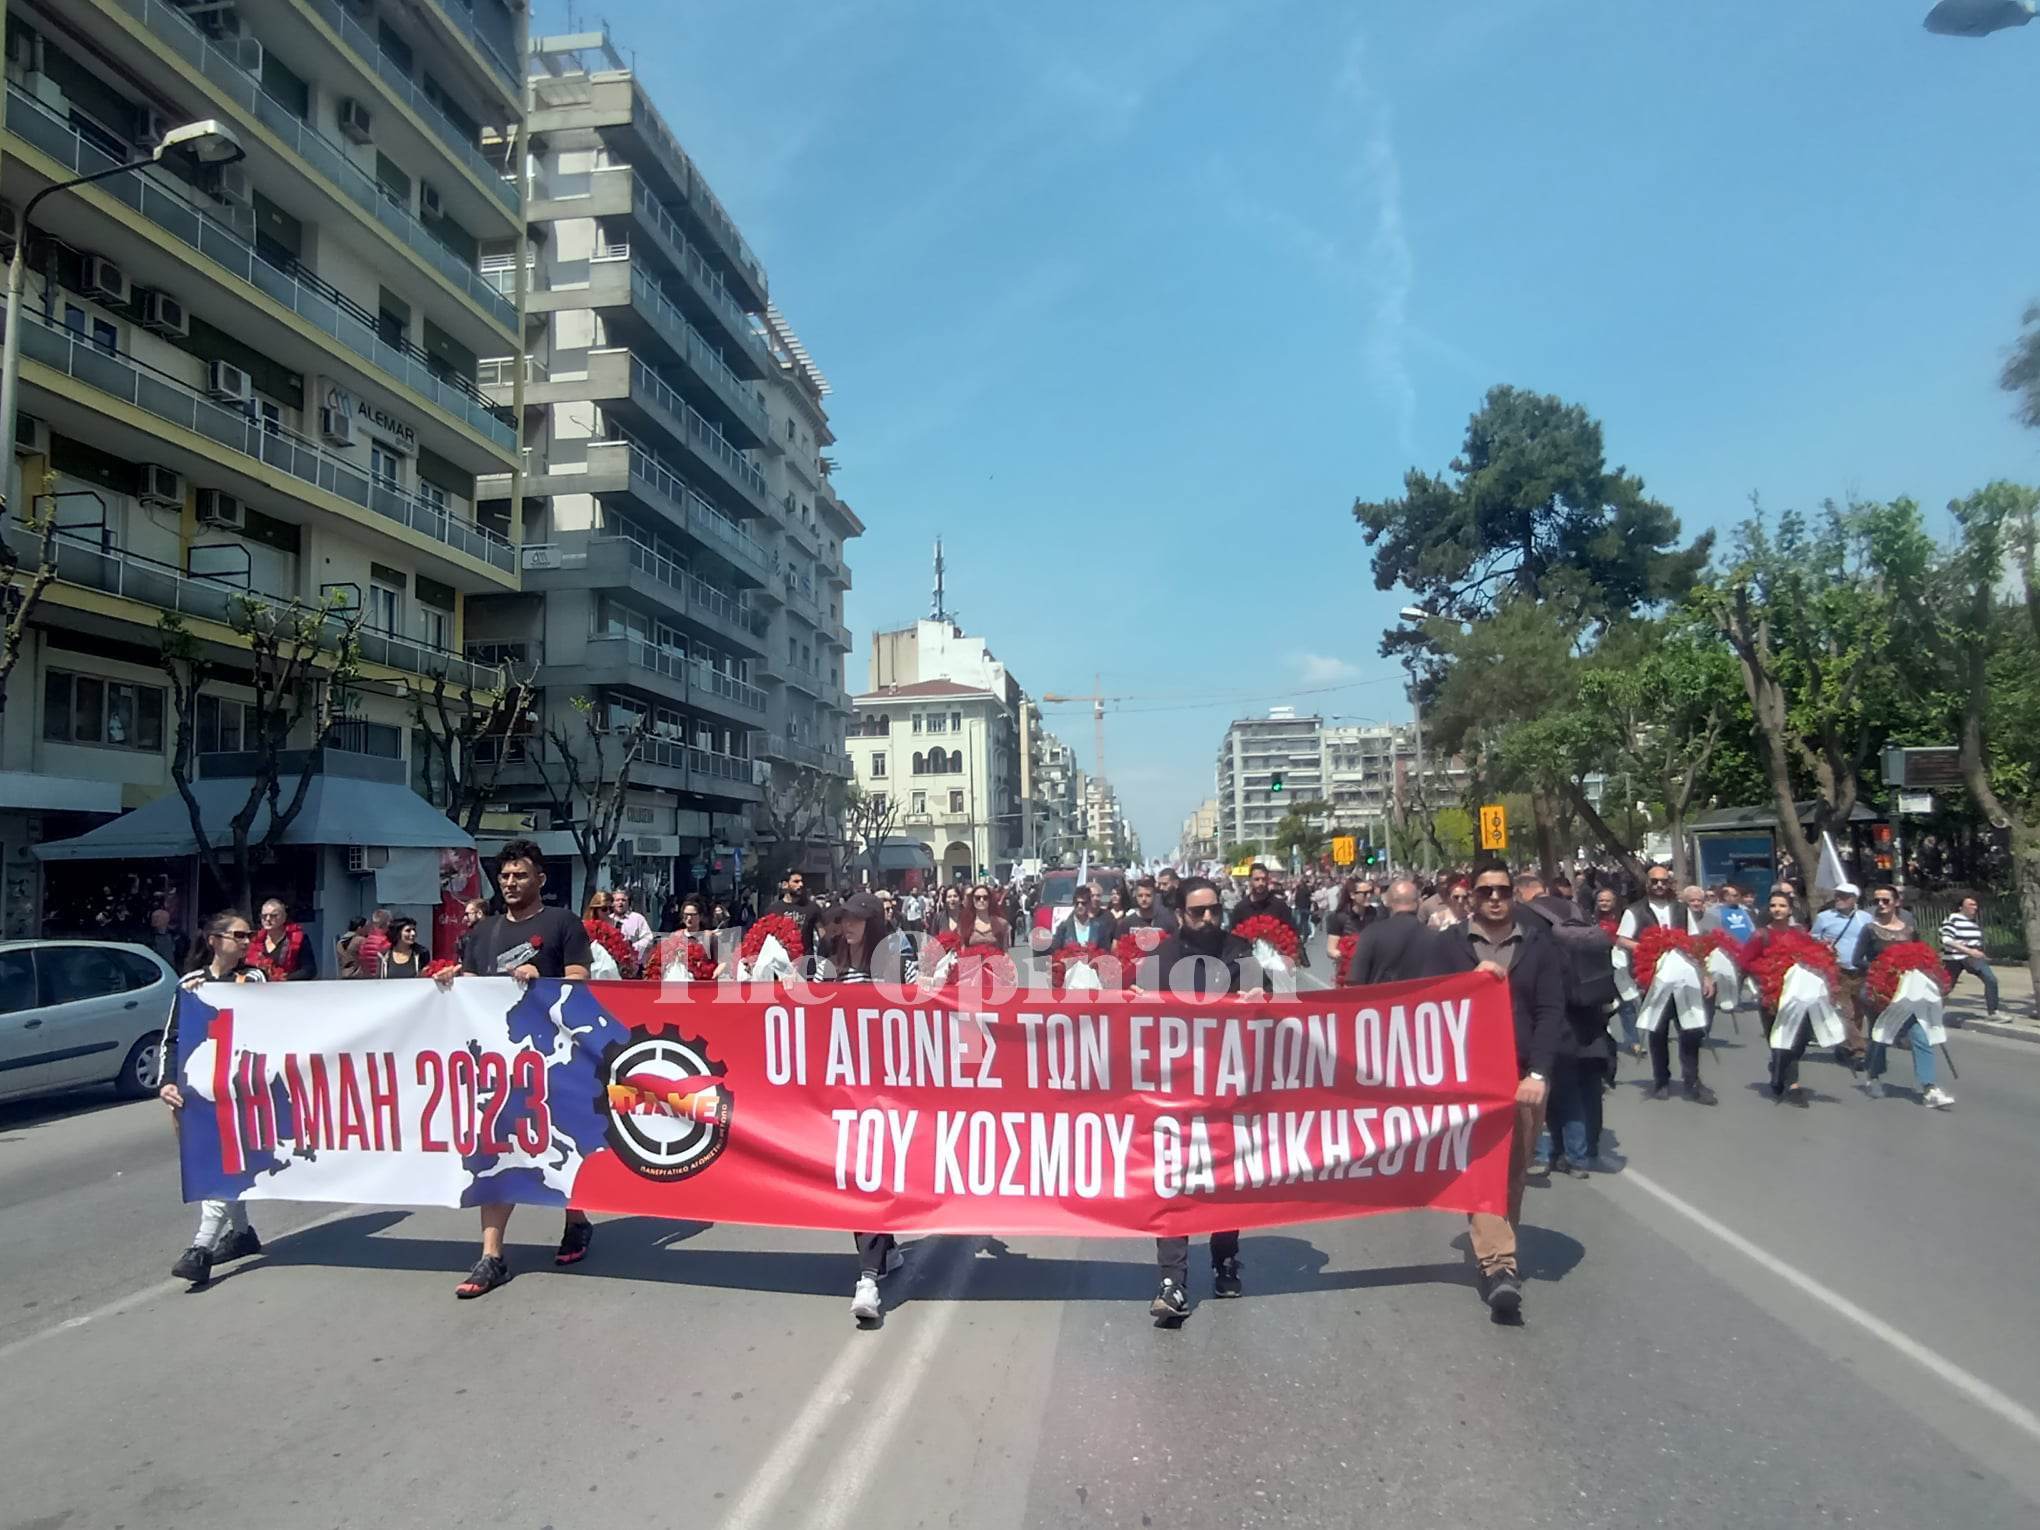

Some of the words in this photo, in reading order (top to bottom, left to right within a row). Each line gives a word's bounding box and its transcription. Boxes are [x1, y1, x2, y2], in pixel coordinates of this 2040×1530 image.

[358, 401, 415, 444] ALEMAR
[765, 1006, 807, 1086] ΟΙ
[825, 1007, 1003, 1088] ΑΓΩΝΕΣ
[1017, 1013, 1110, 1091] ΤΩΝ
[1130, 1013, 1337, 1096] ΕΡΓΑΤΩΝ
[1354, 999, 1471, 1088] ΟΛΟΥ
[415, 1049, 549, 1156] 2023
[832, 1108, 918, 1193] ΤΟΥ
[934, 1110, 1134, 1199] ΚΟΣΜΟΥ
[1153, 1115, 1215, 1199] ΘΑ
[1232, 1103, 1479, 1191] ΝΙΚΗΣΟΥΝ
